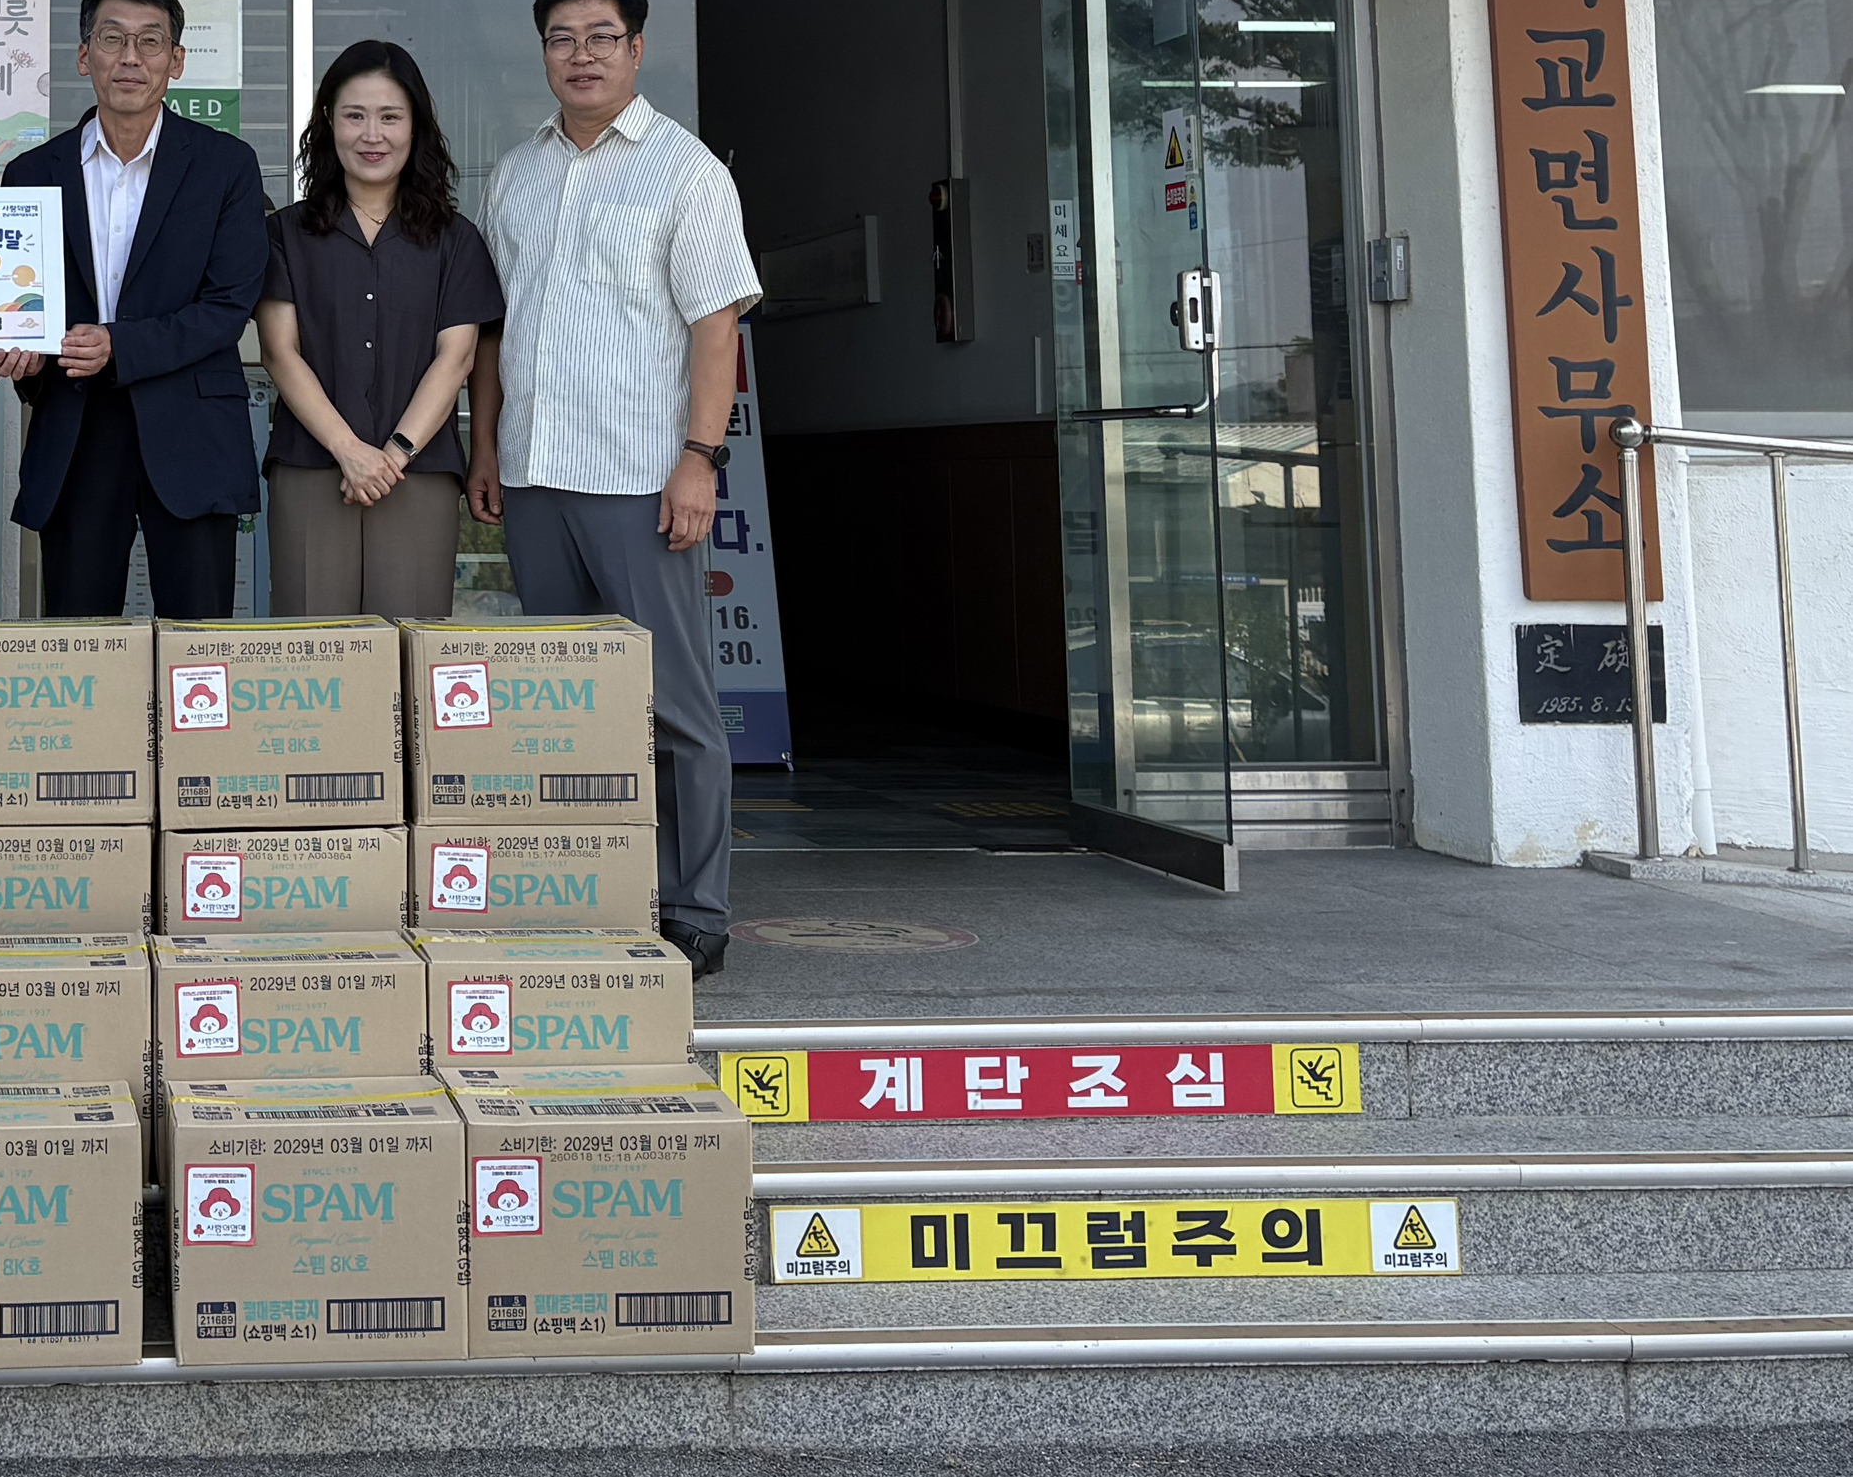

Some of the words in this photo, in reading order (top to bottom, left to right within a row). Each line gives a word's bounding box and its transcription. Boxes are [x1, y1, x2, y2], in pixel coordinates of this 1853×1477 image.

[168, 99, 222, 116] AED
[1055, 204, 1069, 257] 미세요
[42, 639, 69, 652] 03월
[74, 639, 99, 652] 01일
[104, 638, 127, 651] 까지
[187, 642, 235, 657] 소비기한:
[240, 641, 282, 655] 2029년
[287, 641, 315, 654] 03월
[320, 640, 345, 654] 01일
[349, 640, 372, 653] 까지
[440, 642, 488, 656] 소비기한:
[494, 642, 536, 655] 2029년
[541, 642, 568, 655] 03월
[572, 642, 598, 655] 01일
[603, 642, 625, 655] 까지
[231, 677, 342, 712] SPAM
[491, 679, 595, 712] SPAM
[242, 876, 349, 910] SPAM
[489, 874, 598, 908] SPAM
[25, 982, 56, 997] 03월
[61, 981, 90, 996] 01일
[96, 981, 121, 996] 까지
[241, 1016, 361, 1054] SPAM
[513, 1015, 630, 1051] SPAM
[858, 1052, 1226, 1114] 계단조심
[5, 1140, 37, 1157] 03월
[44, 1139, 75, 1156] 01일
[81, 1139, 108, 1155] 까지
[208, 1138, 266, 1156] 소비기한:
[273, 1137, 324, 1155] 2029년
[330, 1137, 363, 1154] 03월
[368, 1136, 399, 1153] 01일
[405, 1136, 433, 1152] 까지
[499, 1135, 556, 1153] 소비기한:
[563, 1135, 613, 1152] 2029년
[620, 1135, 652, 1152] 03월
[657, 1134, 688, 1151] 01일
[693, 1134, 720, 1150] 까지
[597, 1152, 631, 1163] 15:18
[261, 1183, 395, 1224] SPAM
[552, 1179, 683, 1220] SPAM
[910, 1207, 1324, 1272] 미끄럼주의
[786, 1257, 852, 1277] 미끄럼주의
[1383, 1250, 1449, 1270] 미끄럼주의
[200, 1314, 234, 1326] 211689
[490, 1307, 524, 1318] 211689
[243, 1324, 287, 1342] (쇼핑백
[291, 1324, 317, 1341] 소1)
[533, 1317, 577, 1336] (쇼핑백
[580, 1317, 606, 1334] 소1)
